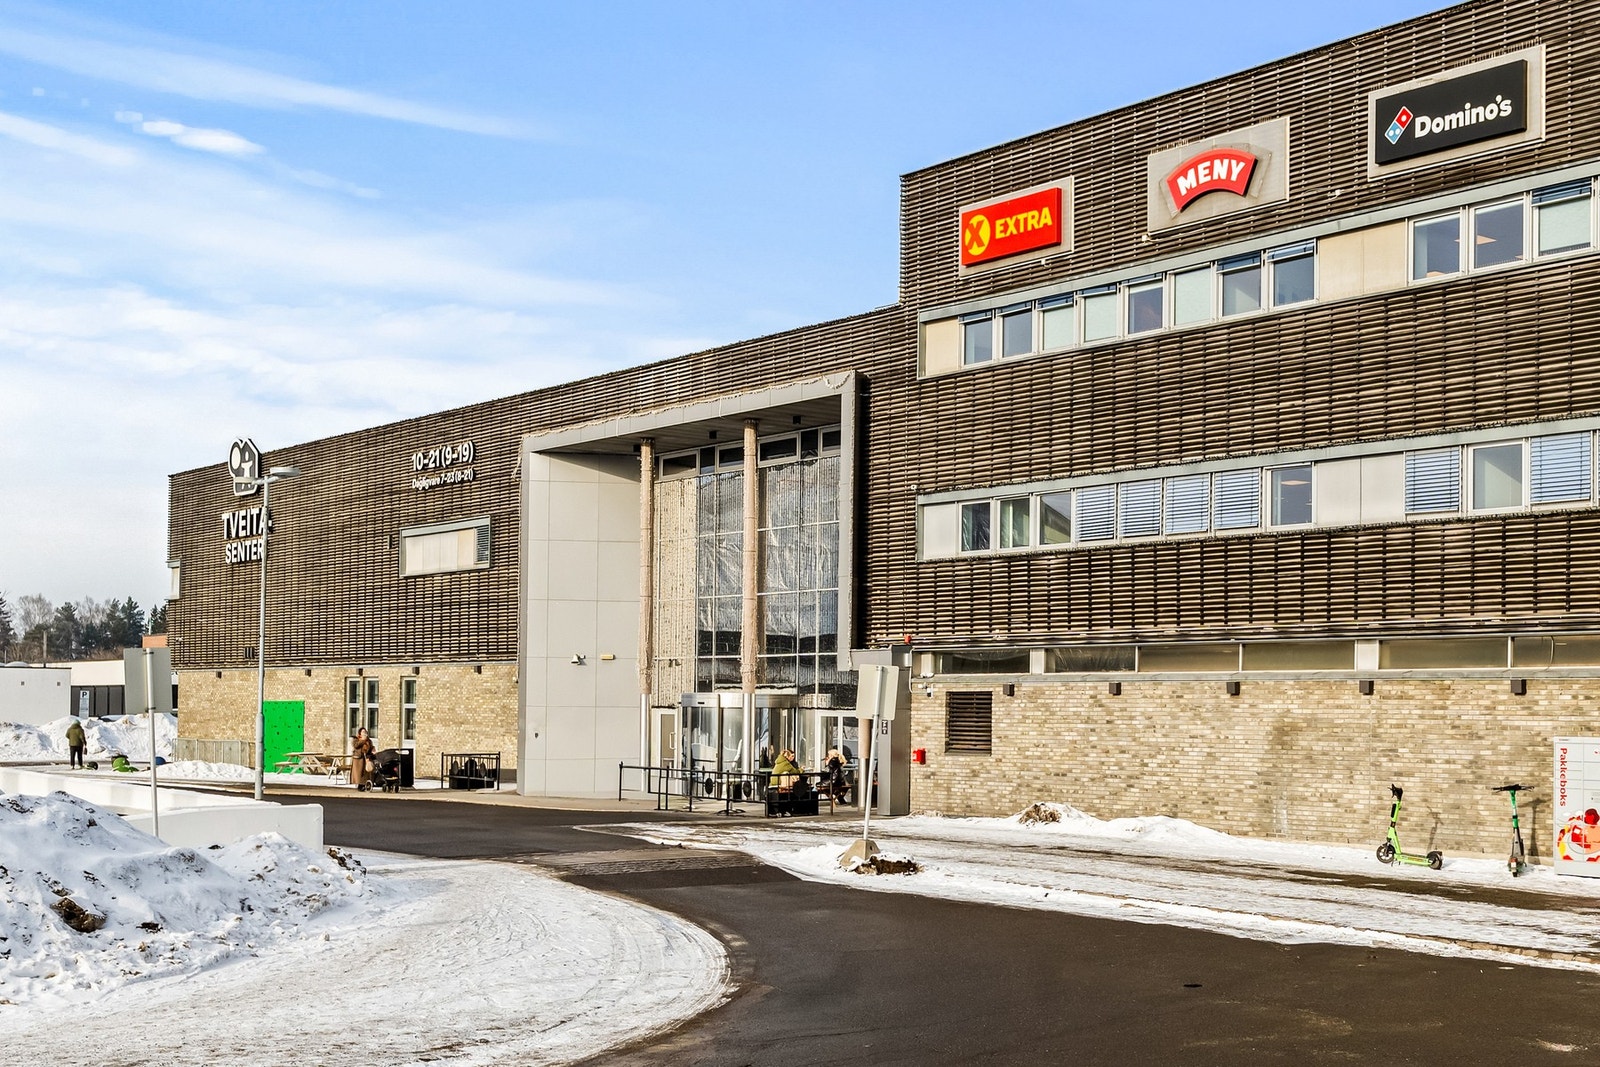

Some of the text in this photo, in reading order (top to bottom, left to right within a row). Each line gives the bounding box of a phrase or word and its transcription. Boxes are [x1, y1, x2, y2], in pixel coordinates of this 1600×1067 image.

[1415, 95, 1512, 138] Domino's
[1177, 159, 1246, 196] MENY
[995, 207, 1053, 239] EXTRA
[1560, 748, 1568, 807] Pakkeboks
